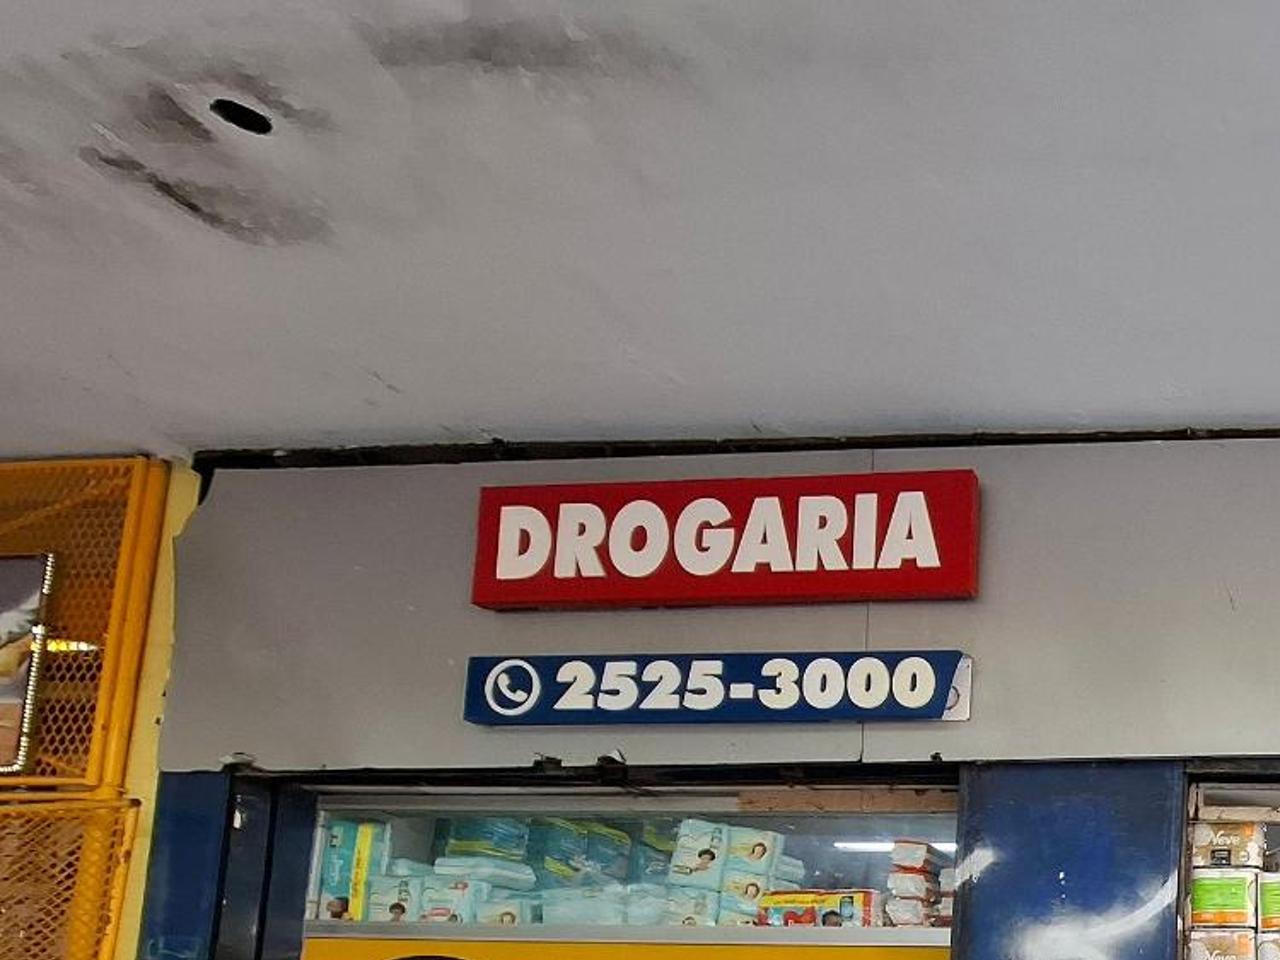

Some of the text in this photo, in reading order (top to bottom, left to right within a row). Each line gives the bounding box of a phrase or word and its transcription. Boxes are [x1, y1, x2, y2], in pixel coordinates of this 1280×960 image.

[496, 490, 941, 581] DROGARIA
[553, 655, 936, 711] 2525-3000
[1210, 830, 1241, 847] Neve
